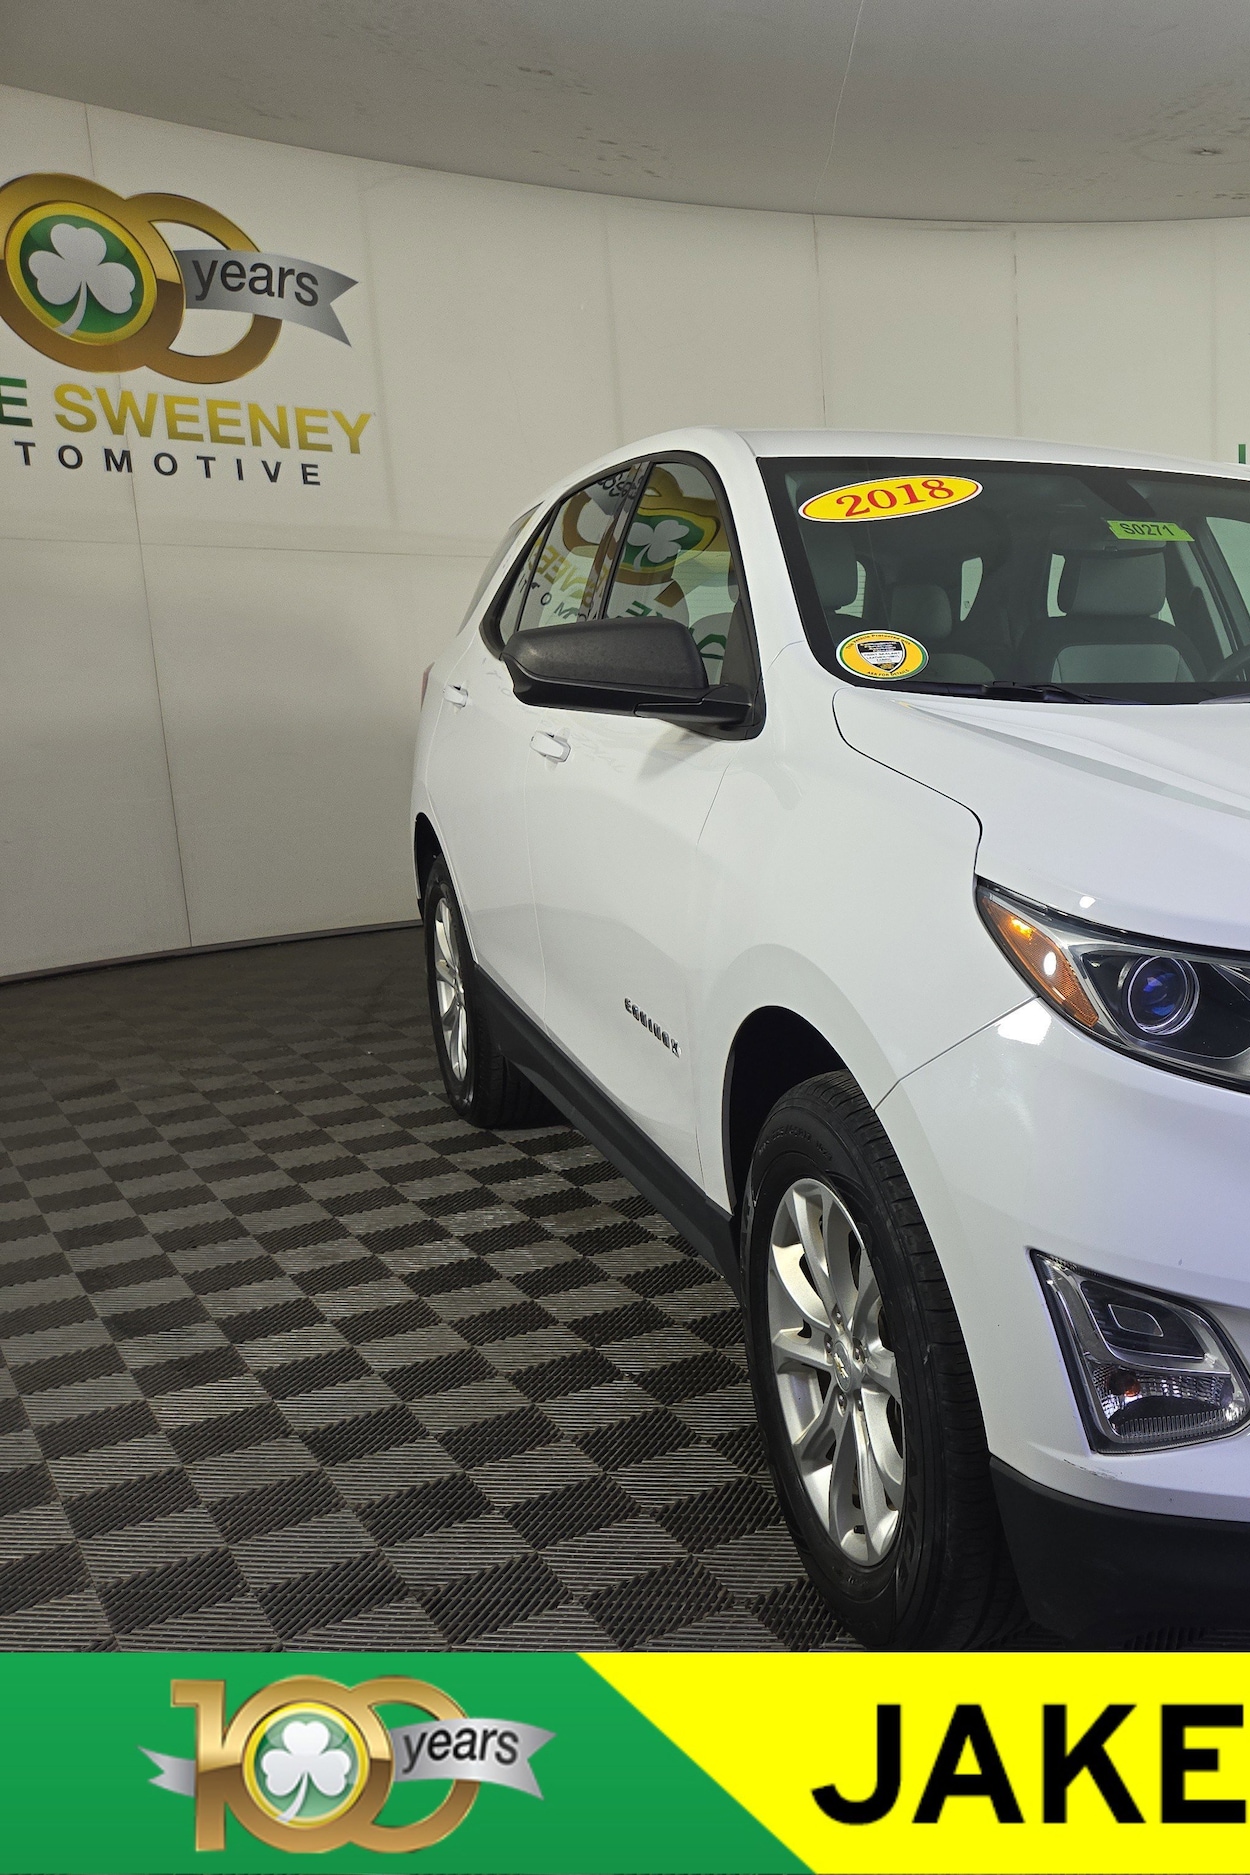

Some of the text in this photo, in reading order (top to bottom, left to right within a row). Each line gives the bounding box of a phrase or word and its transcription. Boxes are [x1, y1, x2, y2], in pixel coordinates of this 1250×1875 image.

[0, 172, 282, 384] 00
[192, 257, 320, 307] years
[53, 382, 372, 455] SWEENEY
[14, 441, 321, 486] TOMOTIVE
[835, 479, 954, 518] 2018
[1120, 523, 1175, 536] S0271
